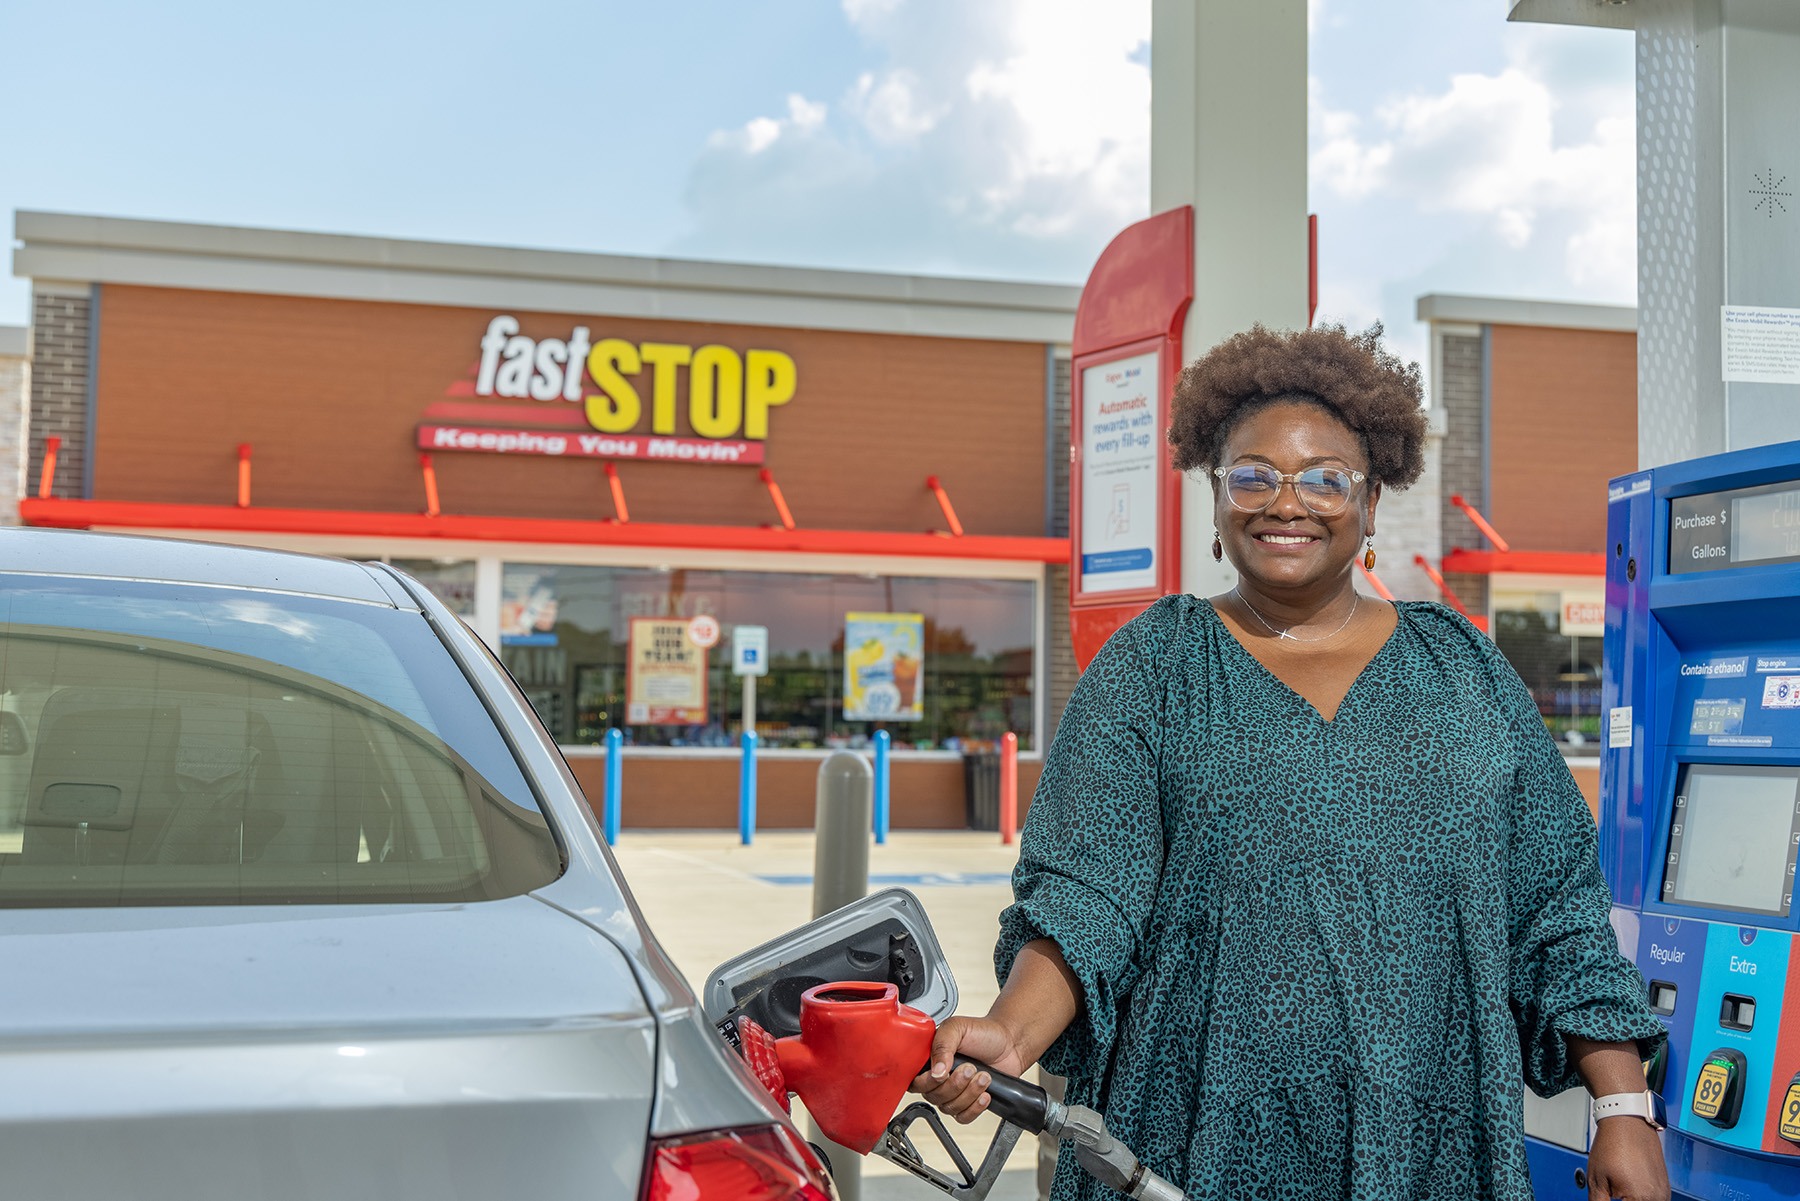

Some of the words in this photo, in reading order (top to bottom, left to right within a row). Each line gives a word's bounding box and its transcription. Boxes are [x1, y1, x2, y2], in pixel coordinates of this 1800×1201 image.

[1098, 393, 1147, 416] Automatic
[1092, 414, 1130, 435] rewards
[1131, 410, 1154, 428] with
[433, 428, 566, 455] Keeping
[579, 435, 638, 457] You
[648, 440, 746, 462] Movin'
[1095, 439, 1120, 454] every
[1121, 432, 1150, 448] fill-up
[1675, 513, 1716, 530] Purchase
[1720, 508, 1727, 526] $
[1692, 544, 1726, 559] Gallons
[1681, 663, 1713, 676] Contains
[1714, 660, 1745, 675] ethanol
[1757, 659, 1768, 669] Stop
[1769, 659, 1786, 669] engine
[1650, 944, 1685, 965] Regular
[1729, 955, 1757, 975] Extra
[1700, 1079, 1722, 1103] 89
[1788, 1099, 1800, 1123] 9
